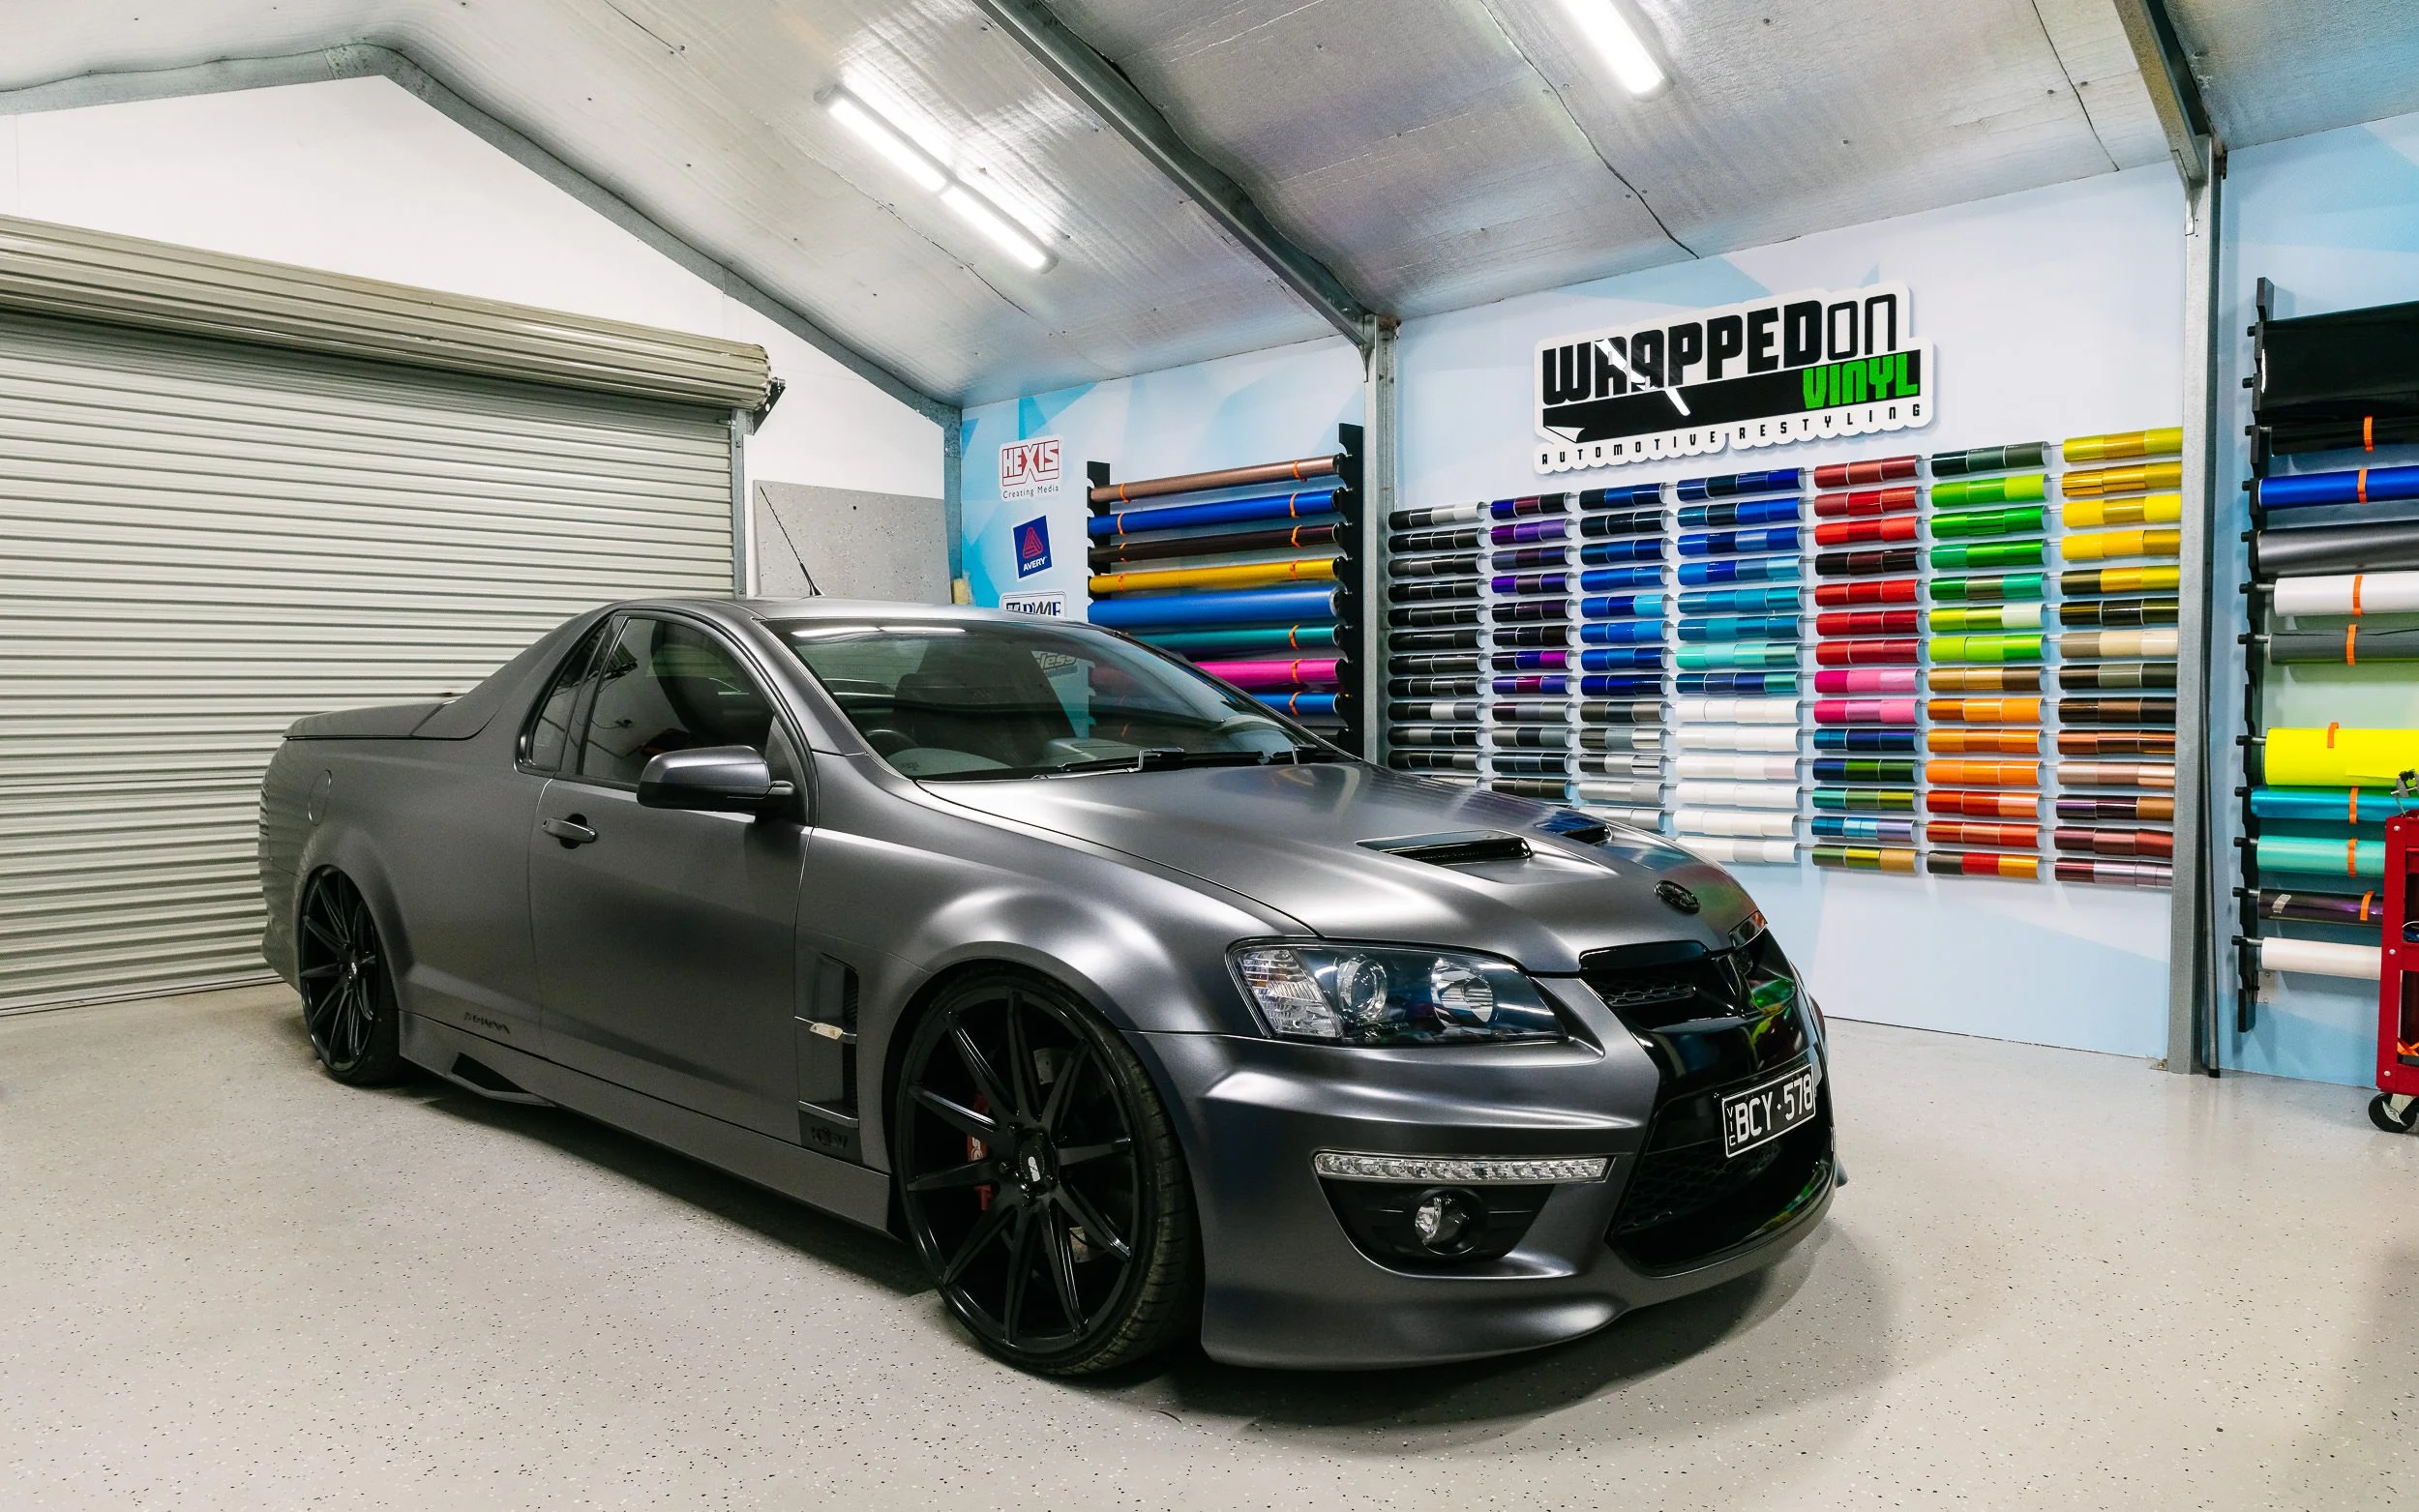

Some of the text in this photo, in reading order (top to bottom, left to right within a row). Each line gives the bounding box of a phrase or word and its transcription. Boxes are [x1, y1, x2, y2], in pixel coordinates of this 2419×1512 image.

[1803, 353, 1919, 409] VINYL
[1541, 403, 1921, 465] AUTOMOTIVE RESTYLING
[1001, 439, 1060, 487] HEXIS
[1002, 485, 1060, 499] Creating Media
[1023, 557, 1046, 572] AVERY
[1726, 1106, 1736, 1146] VIC
